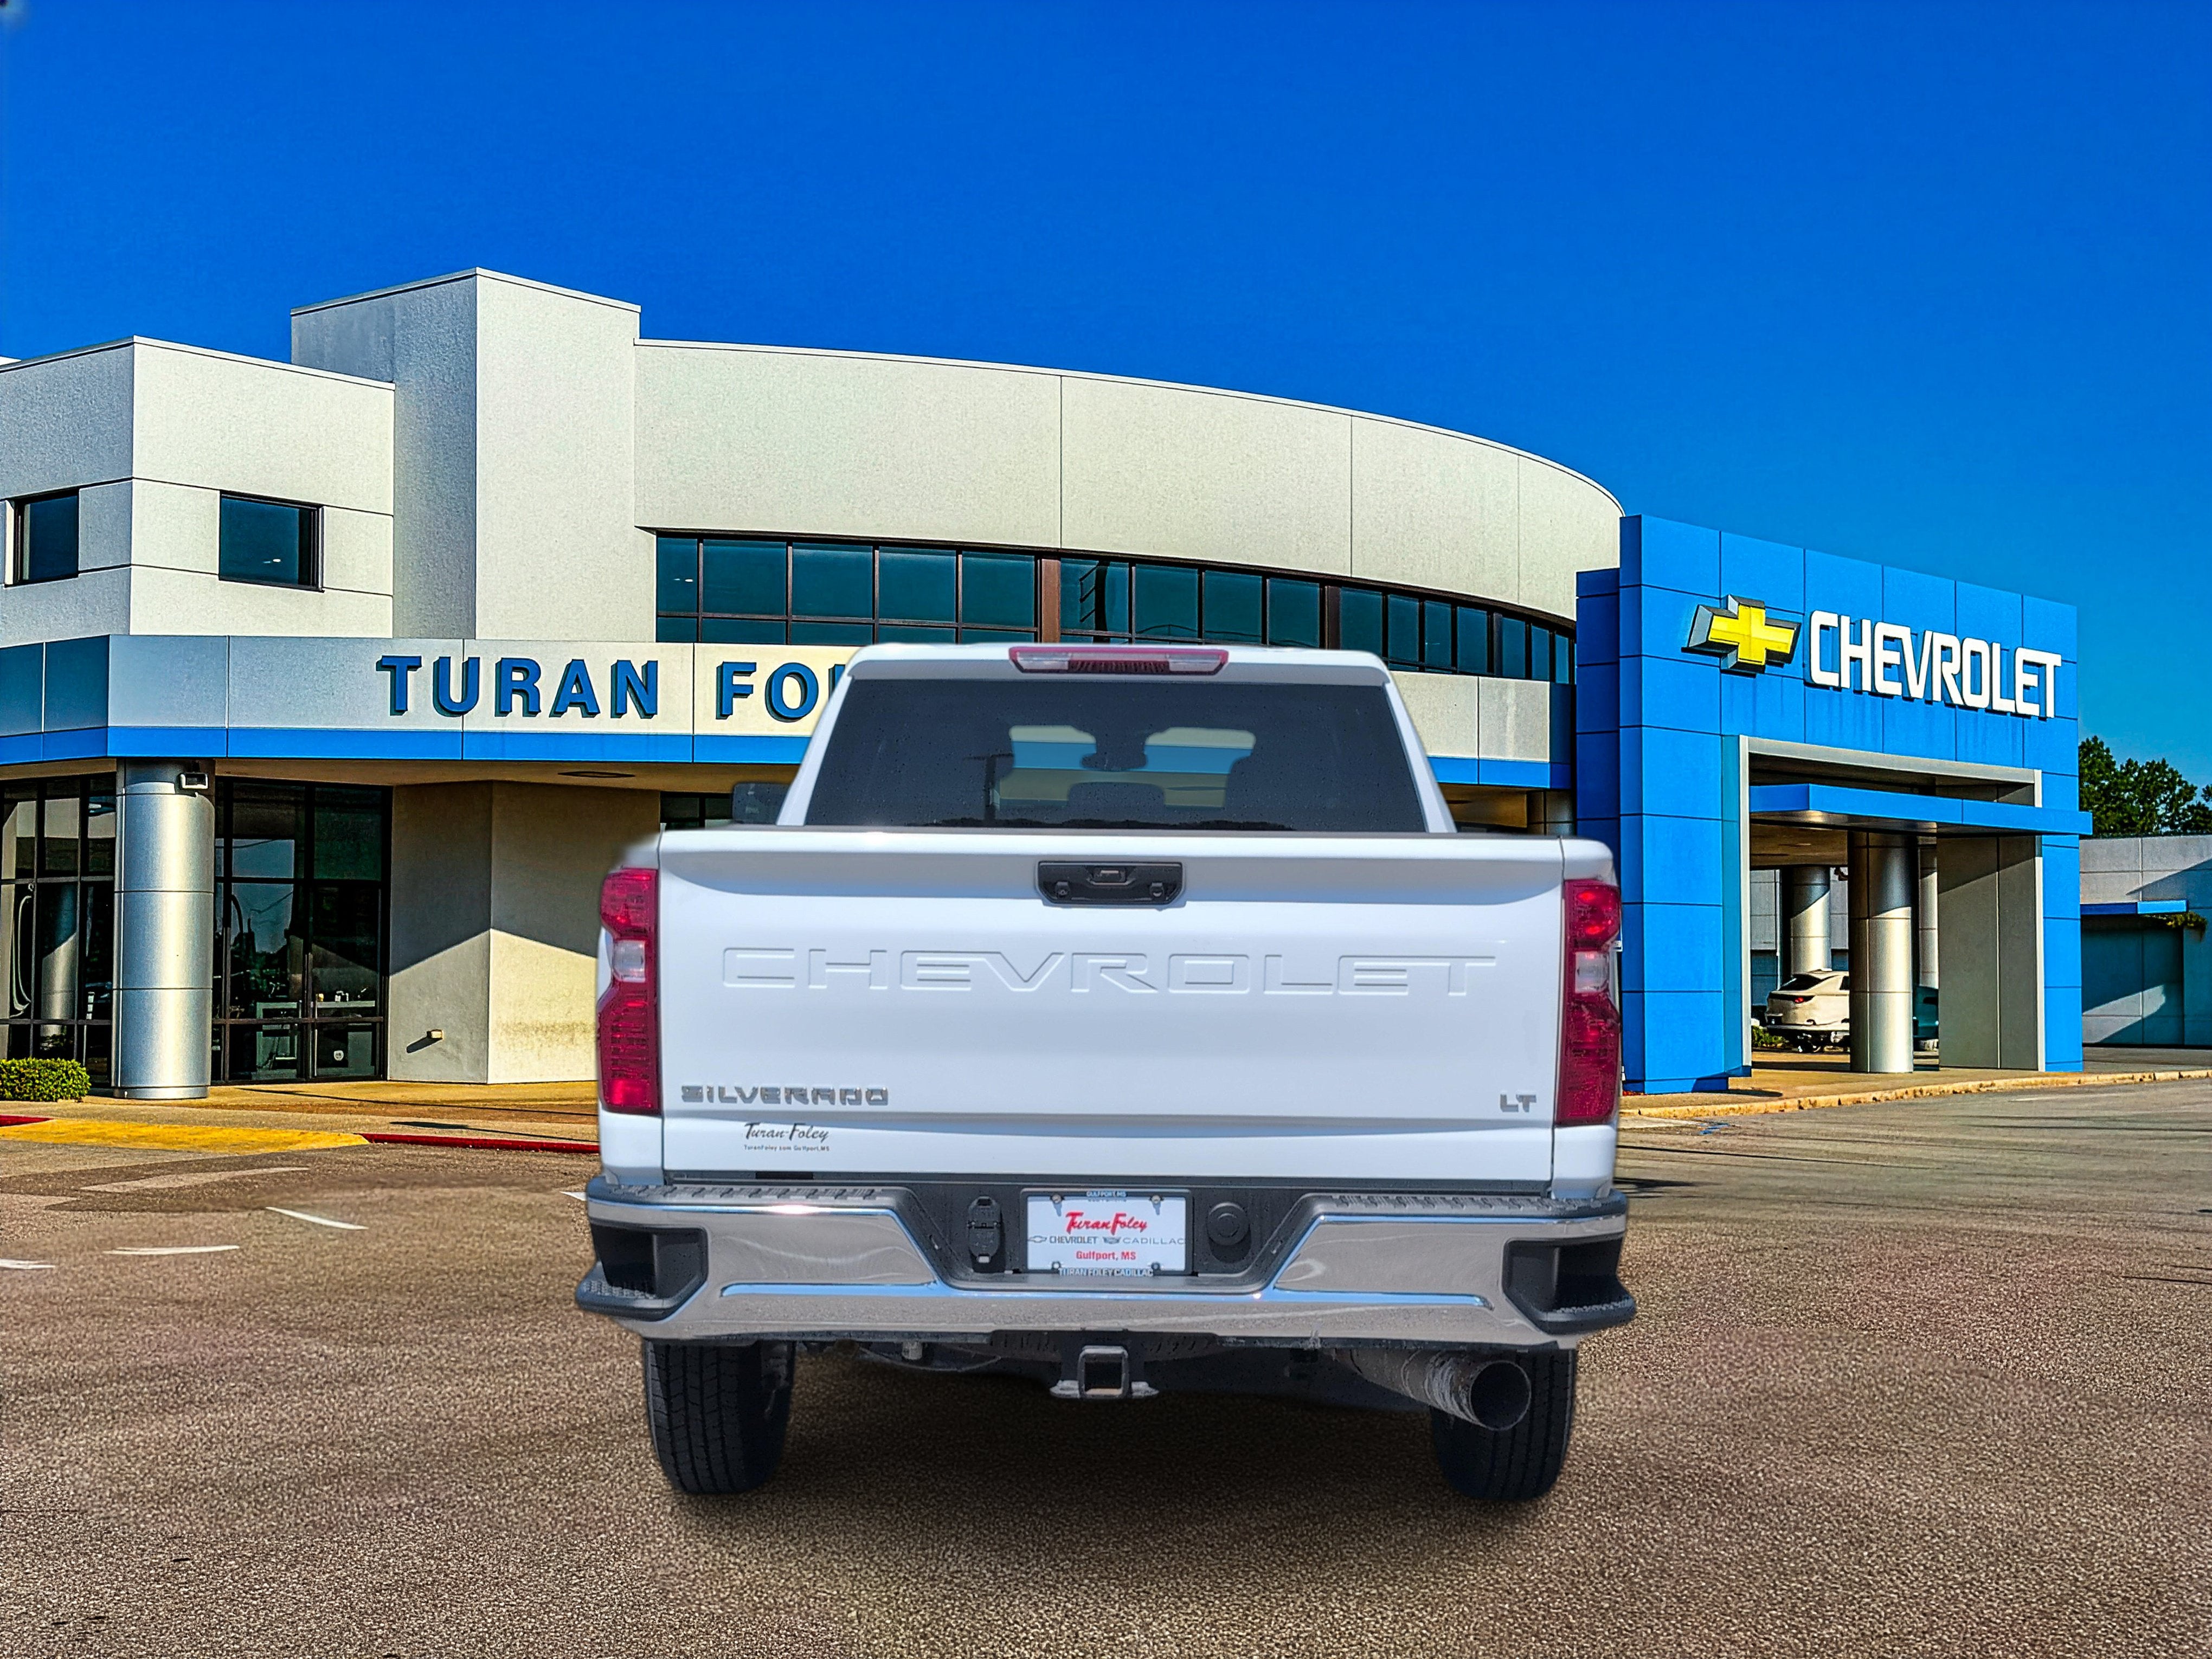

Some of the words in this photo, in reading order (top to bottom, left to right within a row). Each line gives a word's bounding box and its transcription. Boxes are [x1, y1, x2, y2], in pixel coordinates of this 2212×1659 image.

[1808, 610, 2061, 718] CHEVROLET
[375, 654, 658, 719] TURAN
[723, 947, 1496, 996] CHEVROLET
[681, 1085, 889, 1105] SILVERADO
[1500, 1094, 1536, 1113] LT
[1049, 1236, 1097, 1244] CHEVROLET
[1076, 1250, 1118, 1261] Gulfport,
[1121, 1251, 1136, 1260] MS
[1058, 1268, 1086, 1276] TURAN
[1088, 1268, 1112, 1276] FOLEY
[1114, 1268, 1153, 1277] CADILLAC
